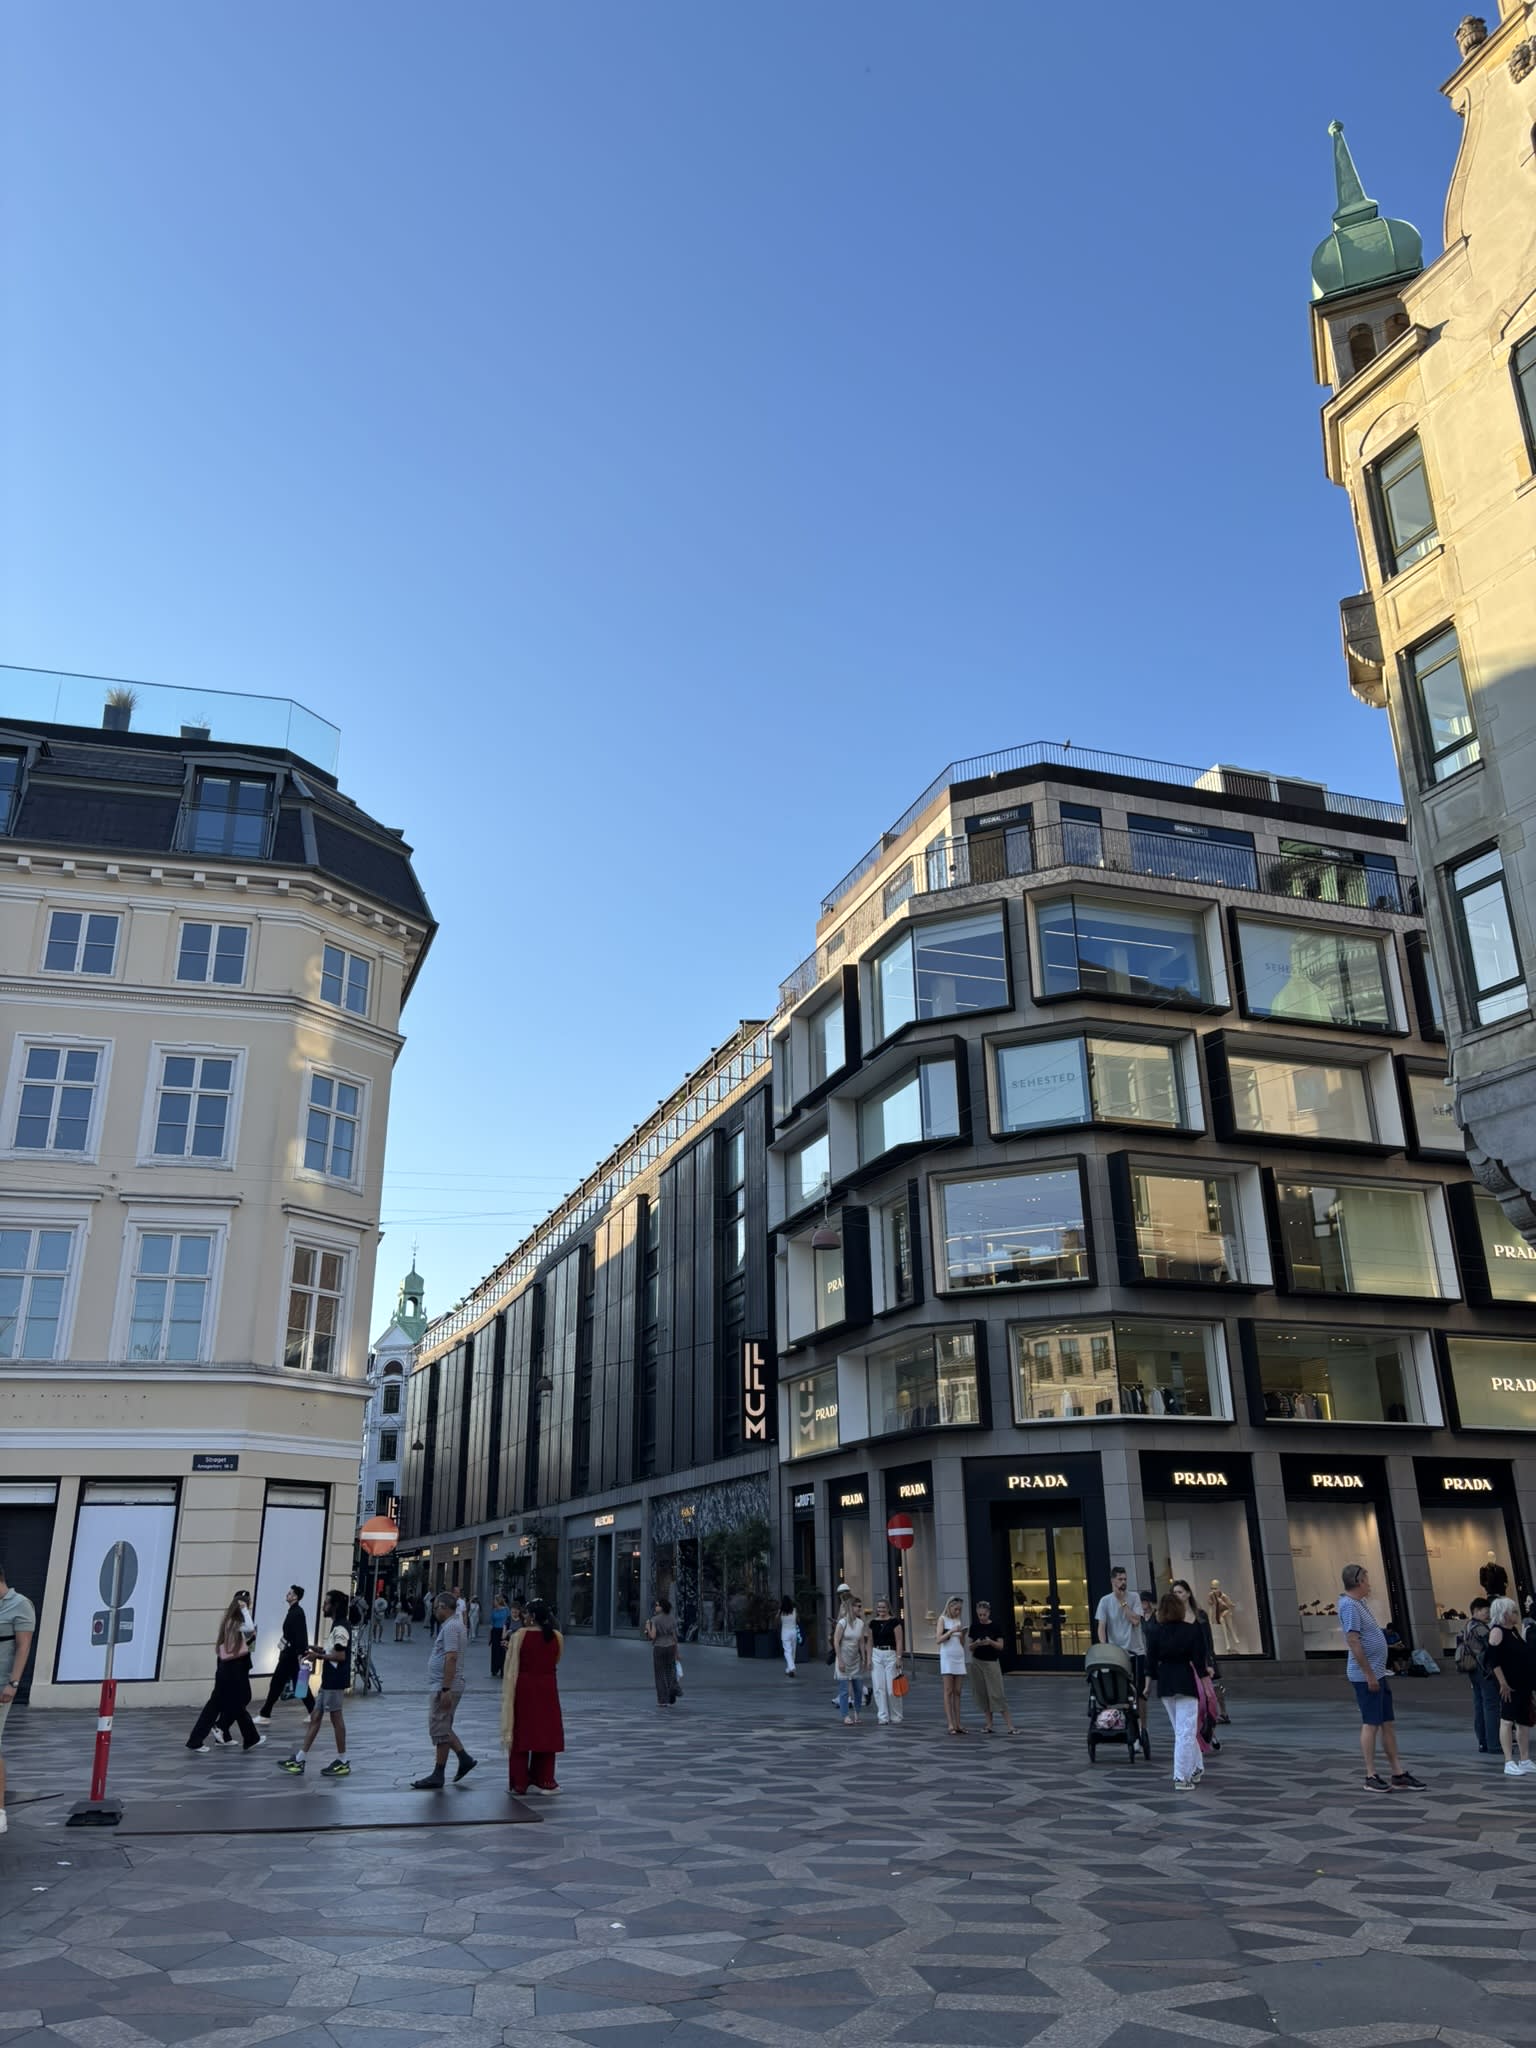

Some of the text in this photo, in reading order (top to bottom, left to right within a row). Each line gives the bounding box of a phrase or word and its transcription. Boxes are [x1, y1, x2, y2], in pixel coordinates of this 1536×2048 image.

[1011, 1072, 1076, 1089] SEHESTED
[827, 1277, 844, 1294] PRA
[744, 1342, 766, 1440] ILLUM
[1008, 1474, 1068, 1489] PRADA
[1174, 1472, 1228, 1486] PRADA
[1312, 1474, 1364, 1488] PRADA
[1443, 1477, 1493, 1491] PRADA
[900, 1483, 926, 1498] PRADA
[841, 1492, 864, 1507] PRADA
[388, 1496, 398, 1526] ILL
